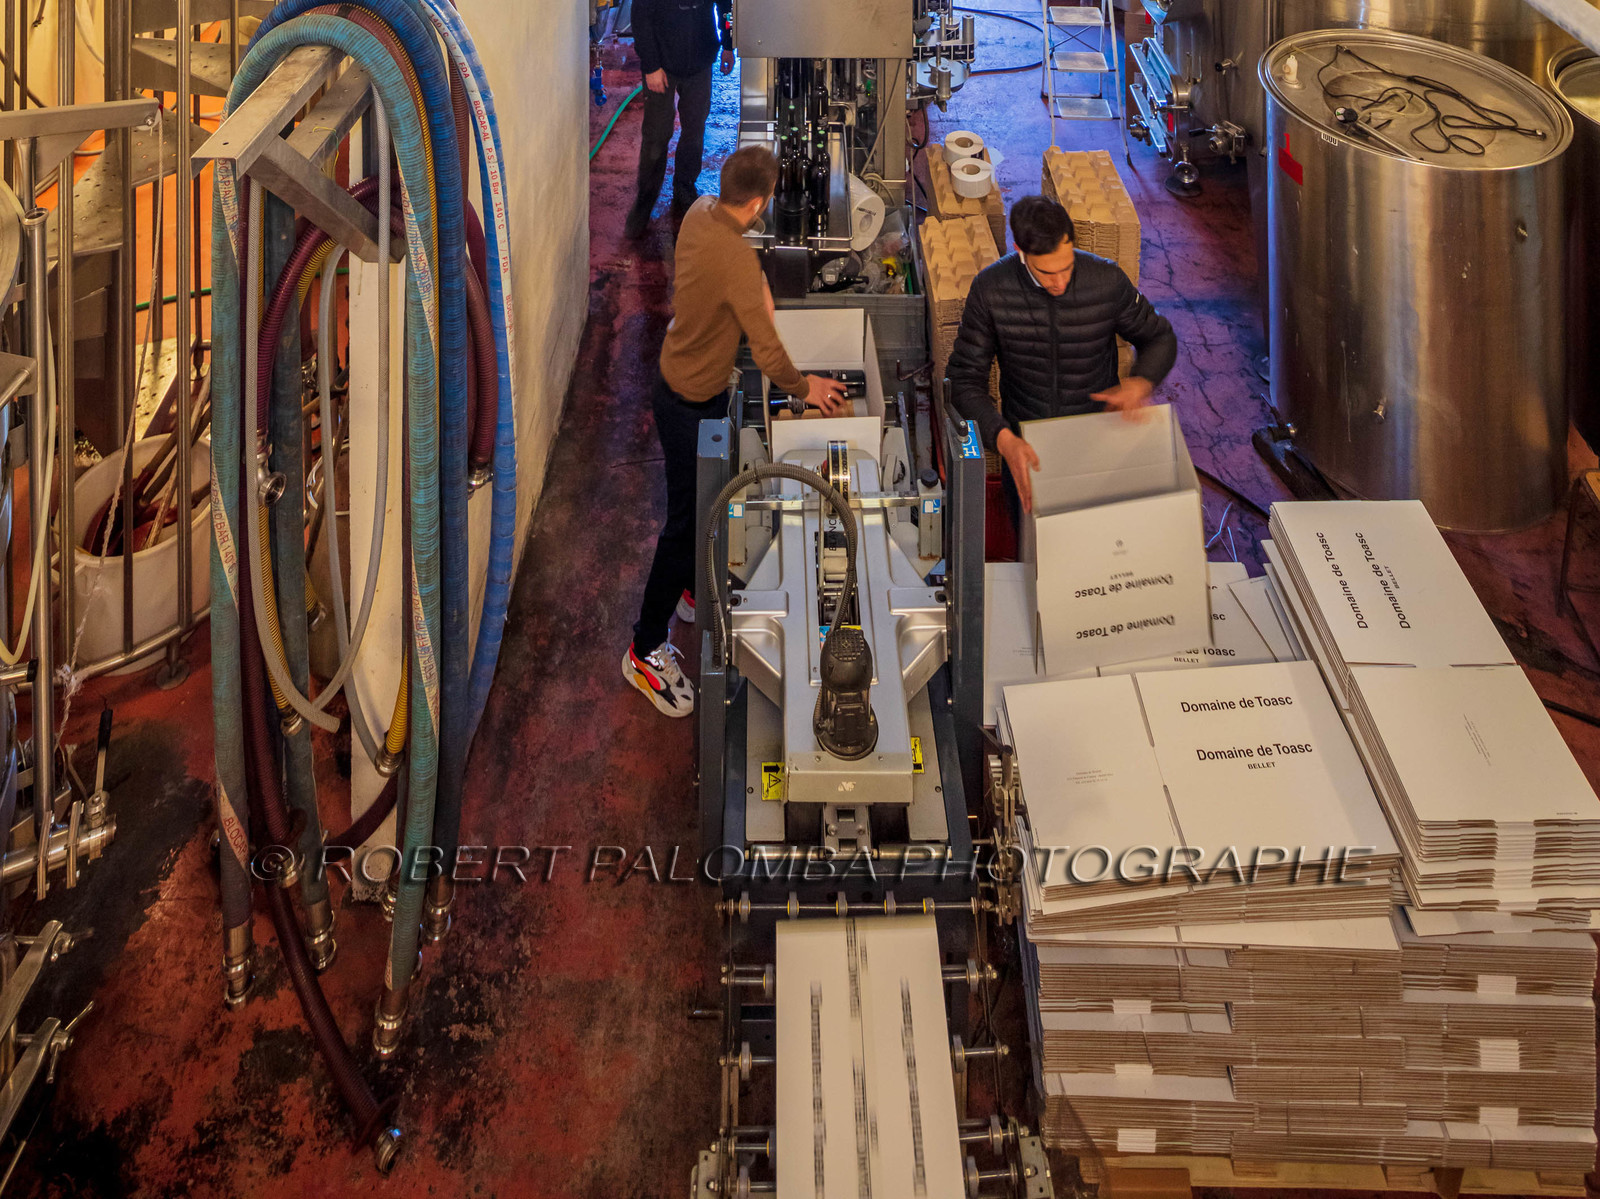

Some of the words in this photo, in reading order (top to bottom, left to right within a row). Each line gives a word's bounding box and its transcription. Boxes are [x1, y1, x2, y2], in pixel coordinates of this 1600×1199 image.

[459, 62, 470, 78] FDA
[1316, 532, 1336, 562] Toasc
[1355, 532, 1375, 562] Toasc
[1331, 564, 1343, 577] de
[1371, 564, 1384, 577] de
[1109, 584, 1123, 593] de
[1125, 574, 1174, 590] Domaine
[1074, 586, 1107, 599] Toasc
[1340, 580, 1369, 629] Domaine
[1380, 580, 1411, 629] Domaine
[1110, 624, 1124, 634] de
[1126, 615, 1176, 631] Domaine
[1076, 627, 1109, 640] Toasc
[1180, 699, 1236, 713] Domaine
[1239, 697, 1255, 708] de
[1254, 695, 1293, 707] Toasc
[1196, 746, 1254, 761] Domaine
[1256, 744, 1273, 757] de
[1272, 742, 1313, 755] Toasc
[1247, 761, 1276, 770] BELLET
